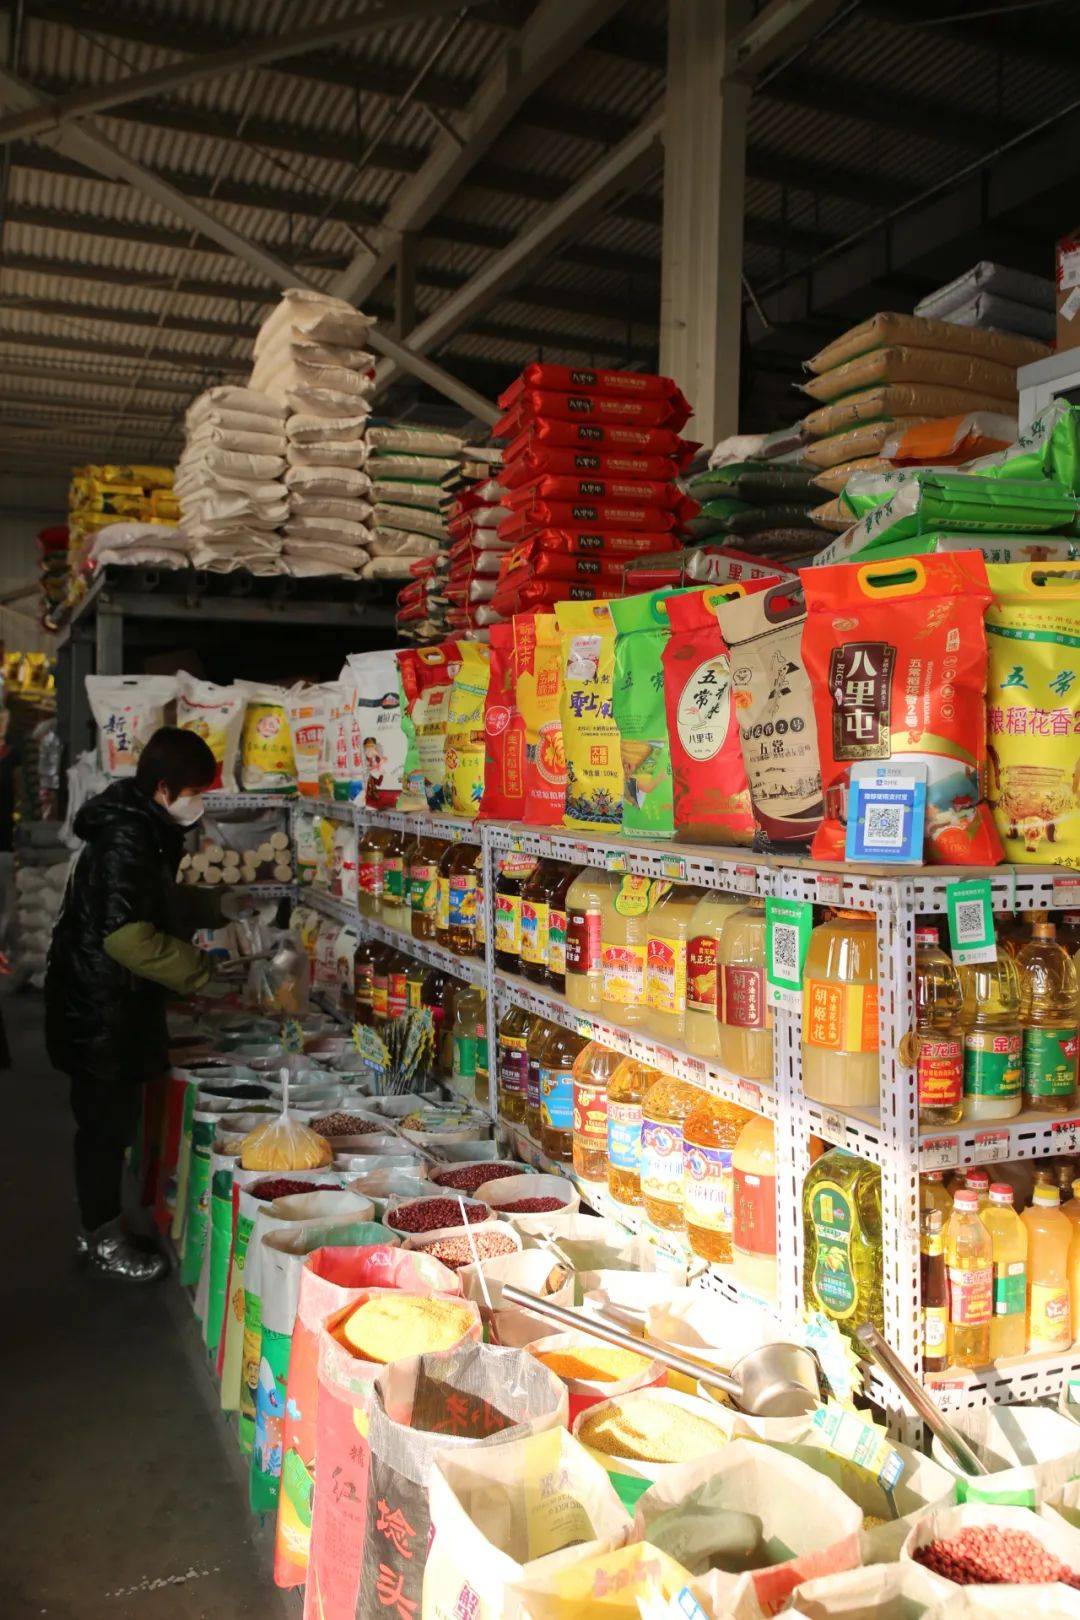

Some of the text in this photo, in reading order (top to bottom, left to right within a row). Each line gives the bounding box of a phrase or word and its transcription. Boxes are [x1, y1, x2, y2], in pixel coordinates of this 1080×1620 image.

[693, 669, 717, 710] 五常
[835, 663, 845, 687] RICE
[1000, 666, 1076, 697] 五常
[845, 650, 877, 739] 八里屯
[689, 732, 713, 744] 八里屯
[814, 988, 828, 1040] 胡姬花
